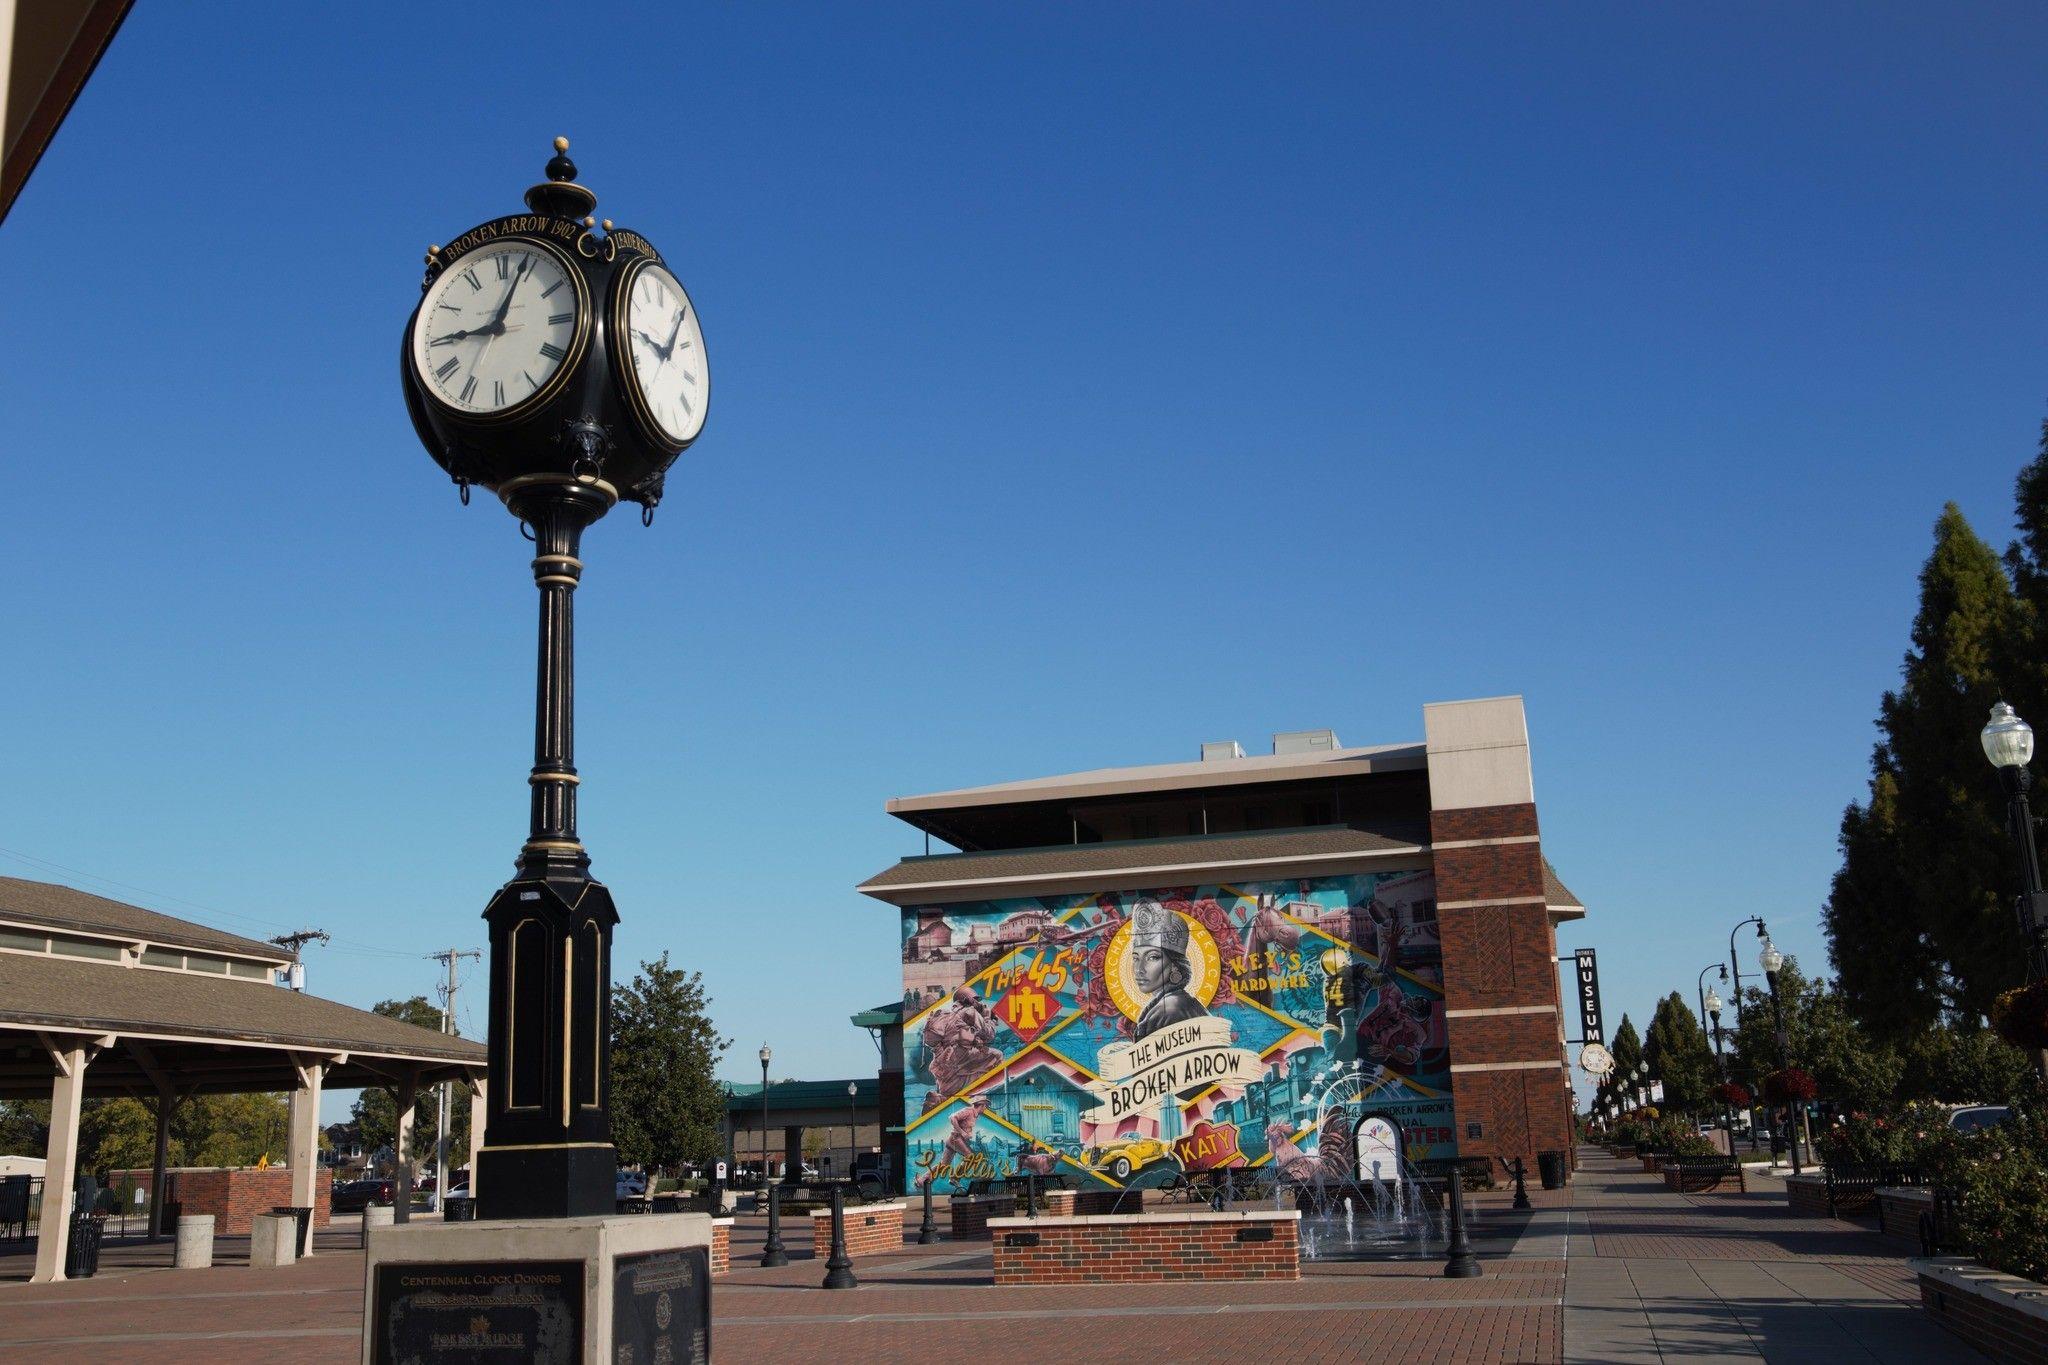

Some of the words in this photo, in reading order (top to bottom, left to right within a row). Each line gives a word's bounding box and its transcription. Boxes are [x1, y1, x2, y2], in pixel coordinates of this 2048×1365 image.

[445, 222, 499, 260] BROKEN
[501, 216, 550, 235] ARROW
[550, 220, 576, 239] 1902
[982, 964, 1025, 998] THE
[1028, 948, 1084, 993] 45TH
[1229, 950, 1302, 977] KEY'S
[1230, 972, 1311, 993] HARDWARE
[1580, 956, 1600, 1041] MUSEUM
[1128, 1044, 1152, 1069] THE
[1154, 1025, 1201, 1058] MUSEUM
[1111, 1065, 1177, 1117] BROKEN
[1184, 1052, 1241, 1084] ARROW
[1415, 1101, 1455, 1115] ARROW'S
[1180, 1130, 1230, 1163] KATY
[401, 1275, 472, 1286] CENTENNIAL
[473, 1274, 512, 1285] CLOCK
[514, 1273, 562, 1285] DONORS
